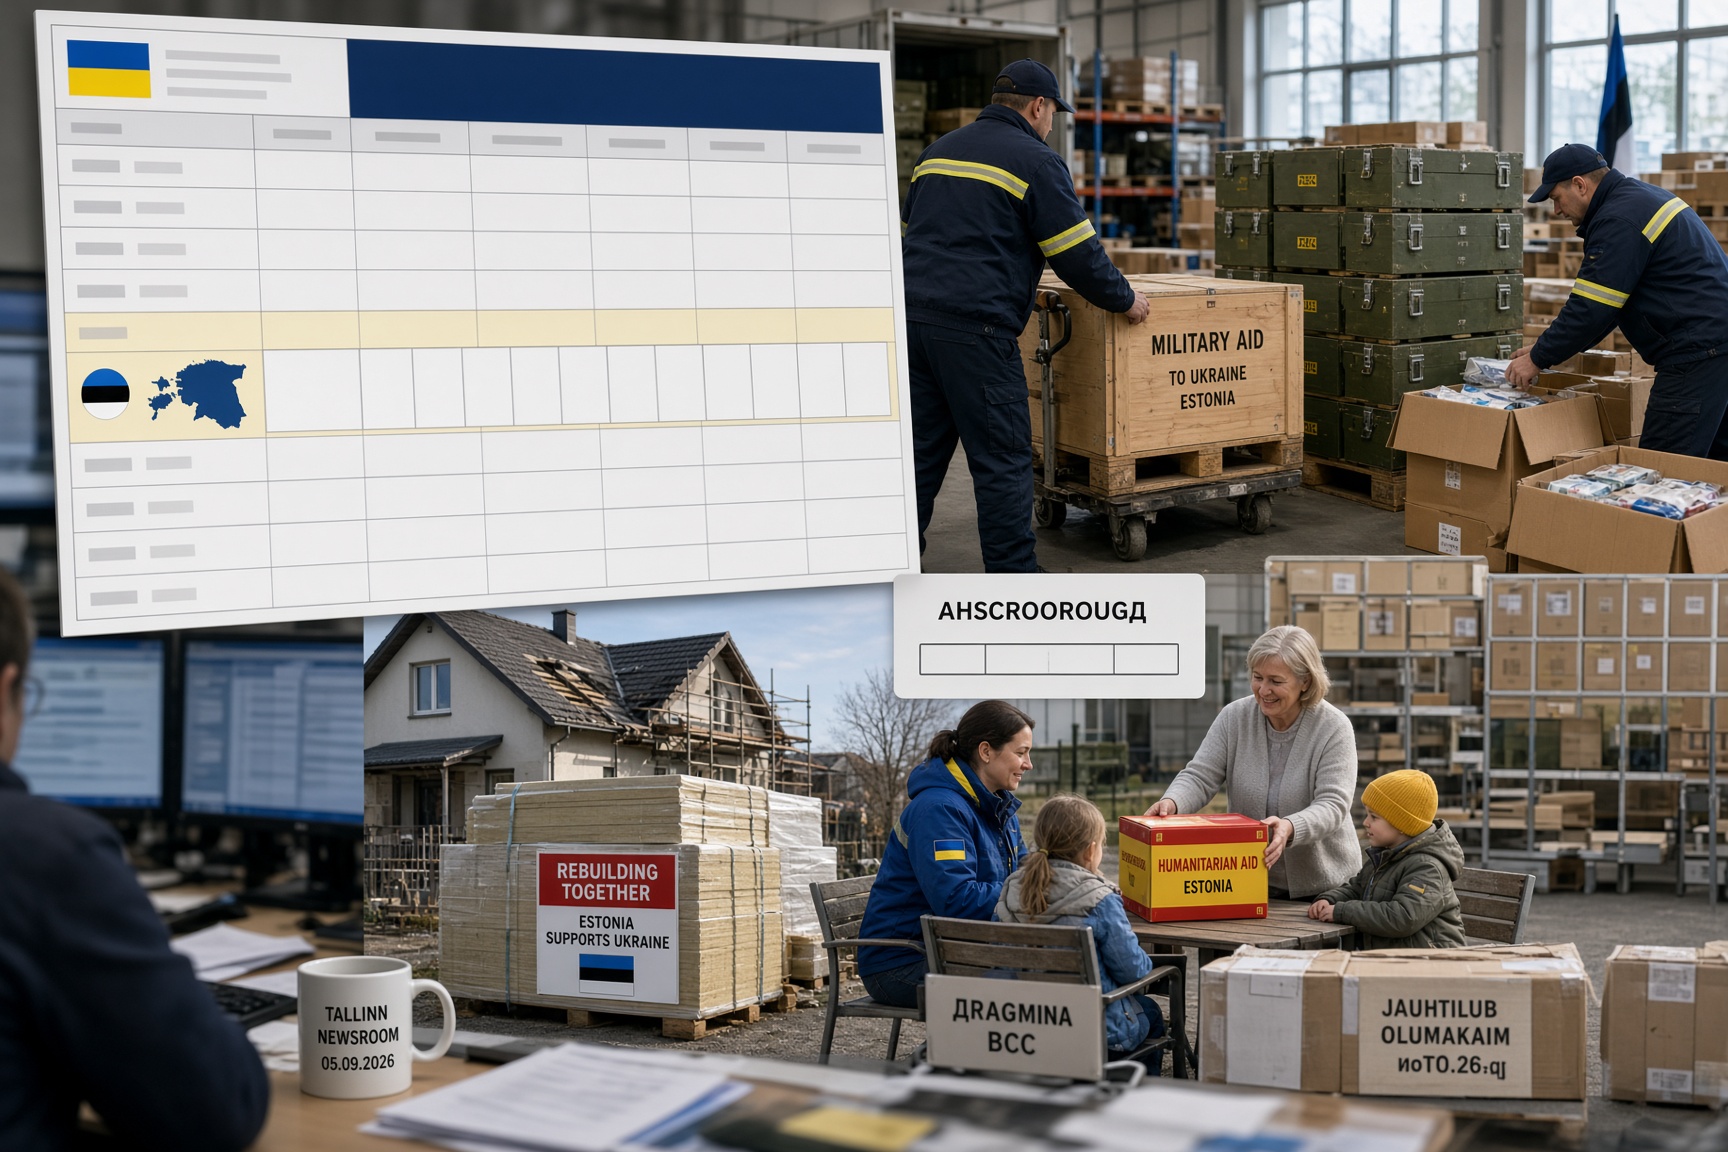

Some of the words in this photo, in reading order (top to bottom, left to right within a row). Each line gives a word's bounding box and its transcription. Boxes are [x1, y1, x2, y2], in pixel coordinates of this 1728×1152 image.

[1151, 330, 1230, 356] MILITARY
[1236, 329, 1264, 350] AID
[1169, 370, 1186, 386] TO
[1190, 365, 1247, 384] UKRAINE
[1180, 390, 1236, 410] ESTONIA
[557, 862, 658, 880] REBUILDING
[1158, 856, 1238, 873] HUMANITARIAN
[1240, 855, 1258, 870] AID
[561, 883, 650, 901] TOGETHER
[1184, 878, 1233, 894] ESTONIA
[579, 915, 634, 930] ESTONIA
[546, 931, 610, 947] SUPPORTS
[614, 934, 670, 949] UKRAINE
[325, 1005, 388, 1022] TALLINN
[1382, 998, 1498, 1018] JAUHTILUB
[317, 1026, 399, 1045] NEWSROOM
[1381, 1026, 1510, 1046] OLUMAKAIM
[321, 1053, 395, 1071] 05.09.2026
